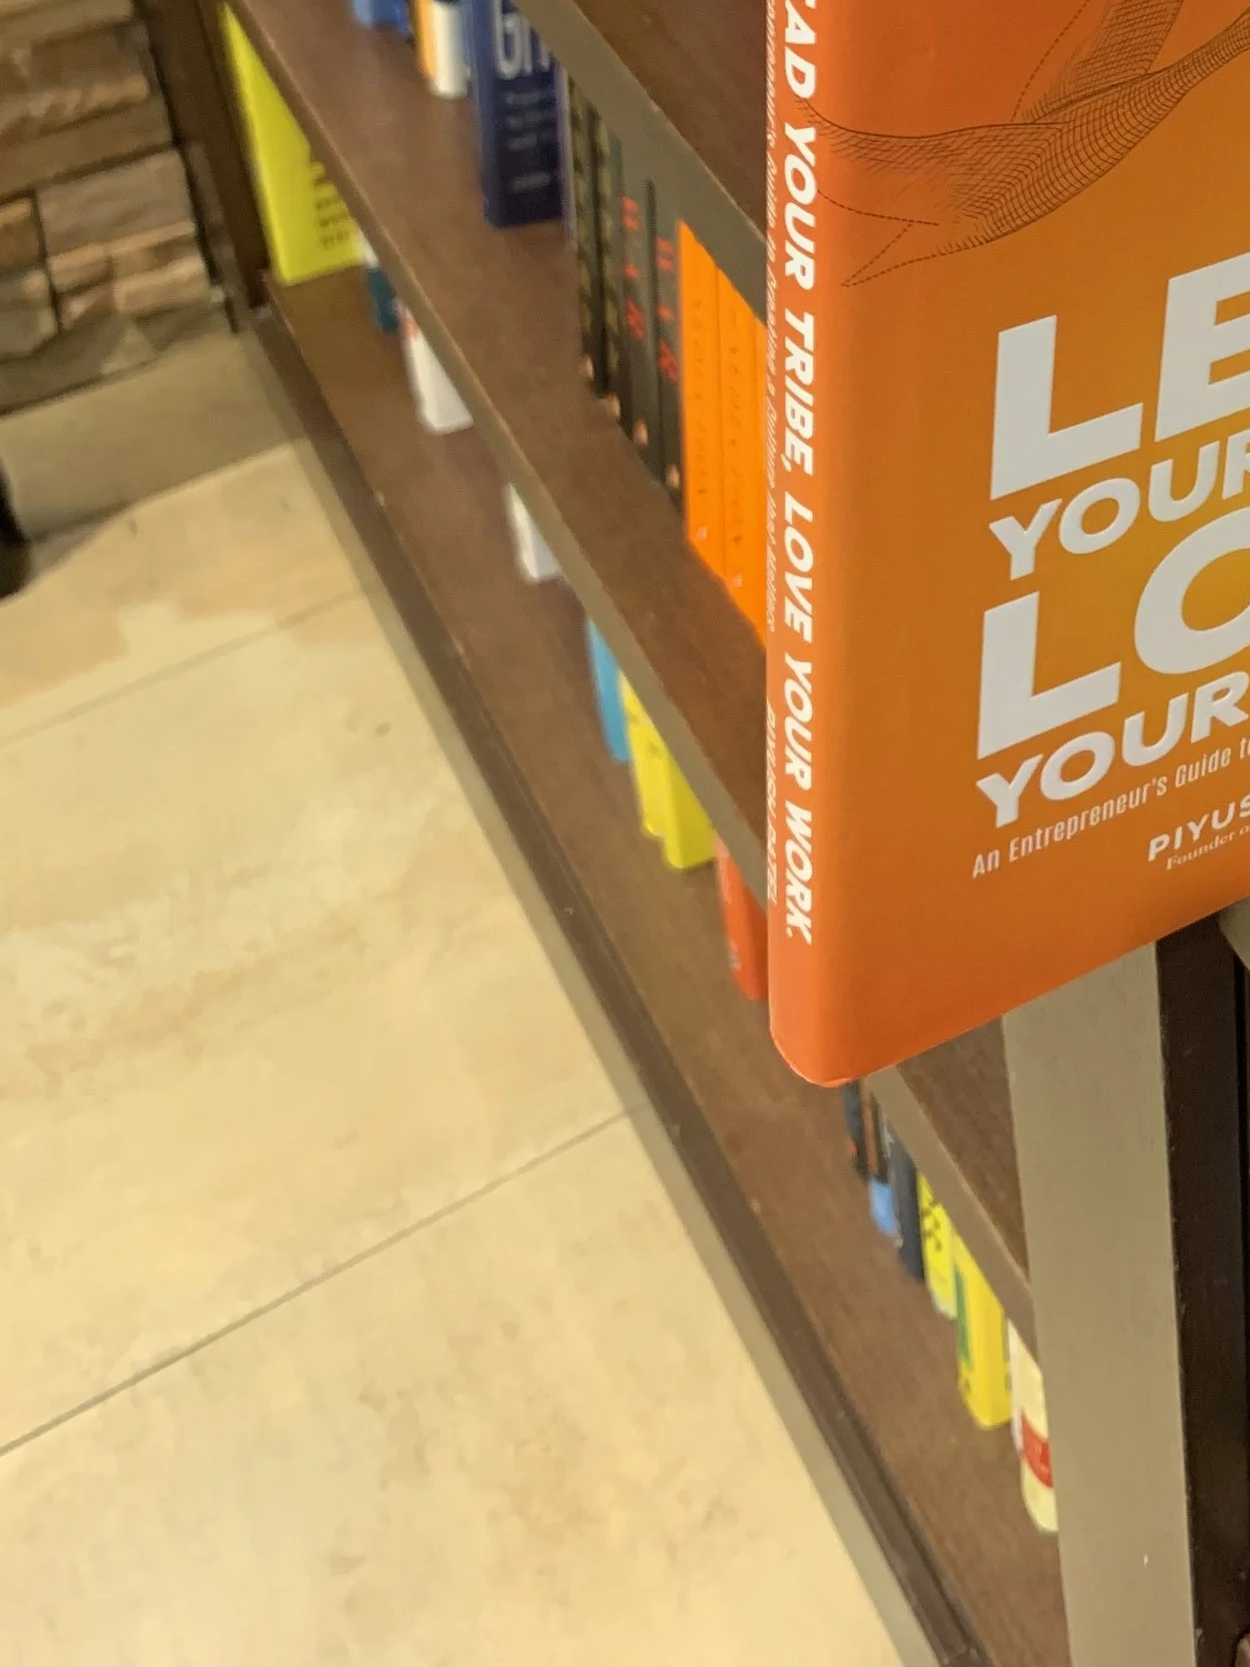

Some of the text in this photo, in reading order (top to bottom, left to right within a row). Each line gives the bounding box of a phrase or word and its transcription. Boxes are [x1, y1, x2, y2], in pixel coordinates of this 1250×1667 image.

[784, 124, 816, 292] YOUR
[782, 308, 815, 476] TRIBE,
[783, 491, 814, 644] LOVE
[783, 653, 814, 792] YOUR
[976, 671, 1250, 830] YOUR
[783, 806, 813, 947] WORK.
[972, 849, 1000, 880] An
[1009, 777, 1167, 862] Entrepreneur's
[1175, 748, 1231, 791] Guide
[1165, 832, 1236, 871] Founder
